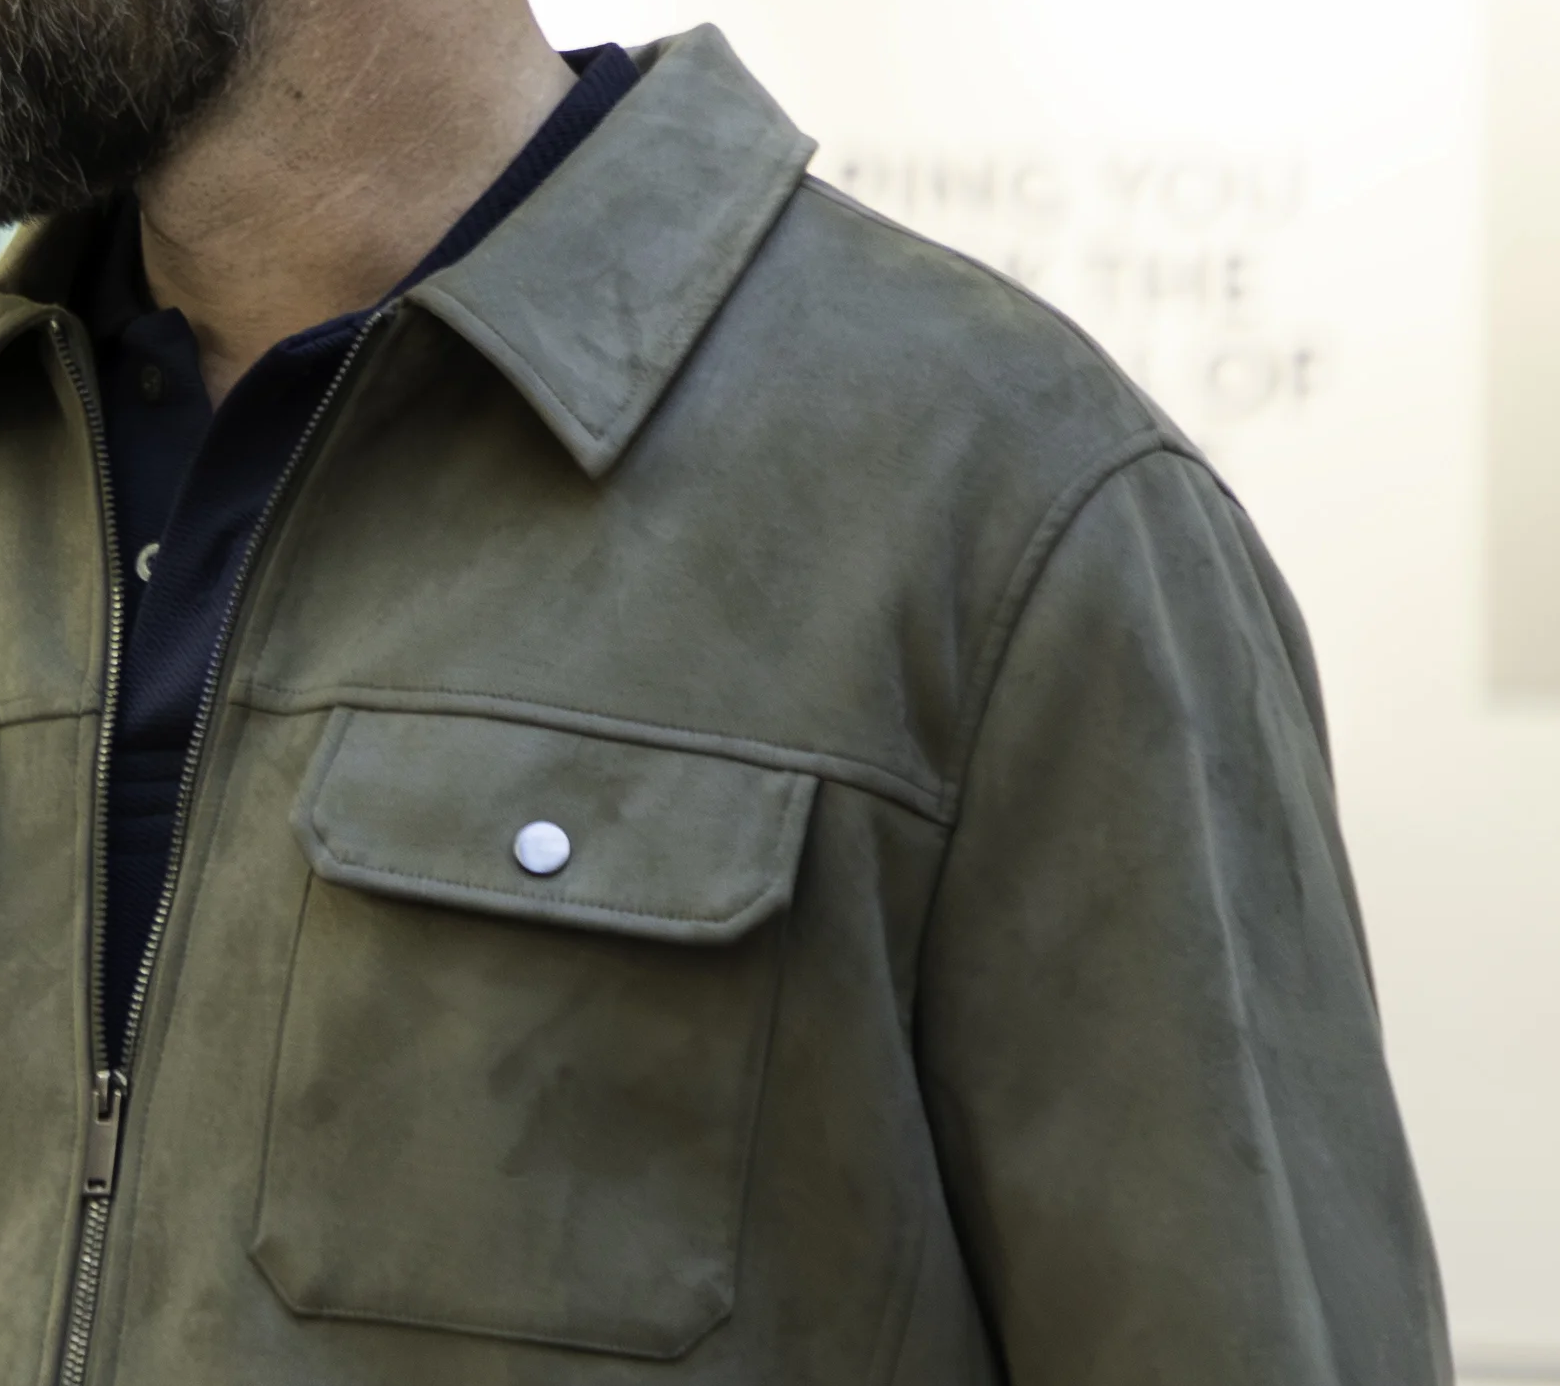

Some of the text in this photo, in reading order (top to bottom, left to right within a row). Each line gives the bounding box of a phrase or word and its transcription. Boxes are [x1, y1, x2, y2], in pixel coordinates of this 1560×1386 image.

[1105, 153, 1305, 225] YOU
[1090, 251, 1252, 315] THE
[1204, 345, 1326, 415] OF
